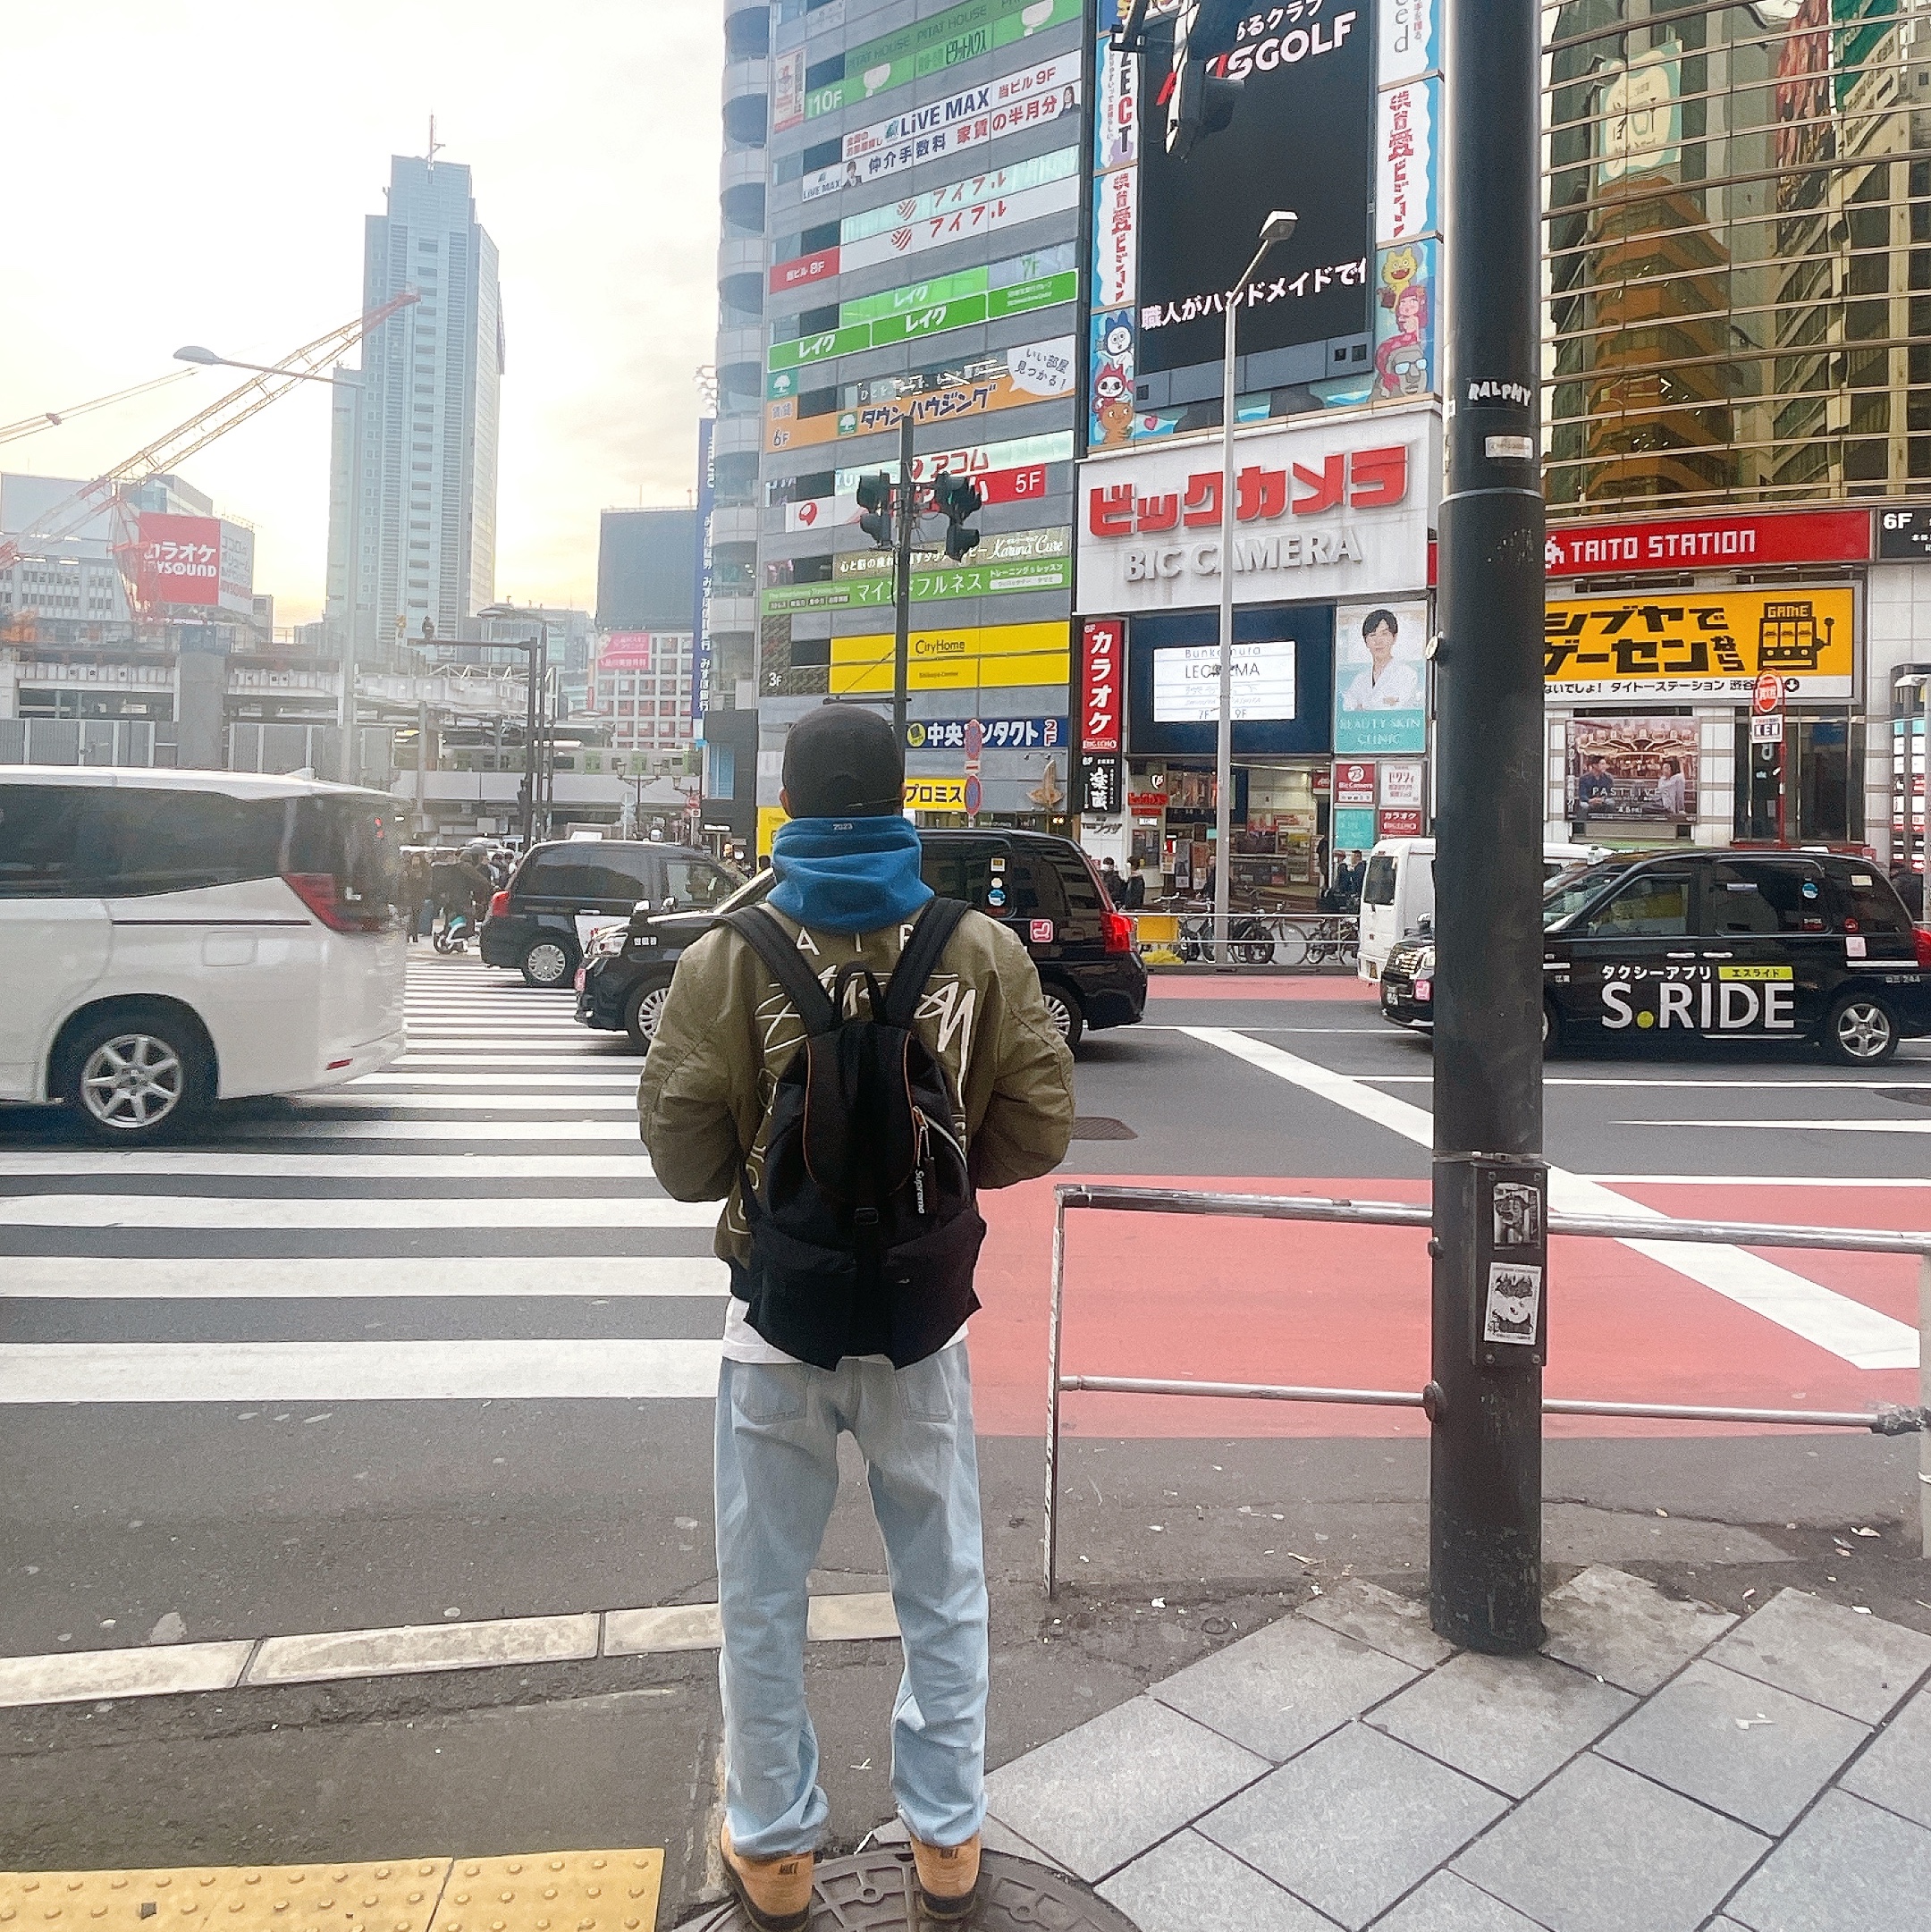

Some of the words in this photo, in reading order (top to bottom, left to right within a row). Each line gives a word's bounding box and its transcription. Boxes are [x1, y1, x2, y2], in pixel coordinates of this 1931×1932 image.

[1036, 66, 1057, 85] 9F
[945, 87, 991, 121] MAX
[868, 133, 946, 174] 仲介手数料
[932, 173, 1007, 208] アイフル
[930, 199, 1007, 239] アイフル
[895, 285, 929, 308] レイク
[905, 305, 947, 333] レイク
[797, 333, 836, 359] レイク
[1026, 348, 1070, 375] いい部屋
[860, 384, 997, 429] タウンハウジング
[1468, 381, 1531, 407] RALPHY
[772, 430, 789, 447] 6F
[930, 449, 990, 479] アコム
[1014, 471, 1041, 494] 5F
[1089, 445, 1408, 536] ビックカメラ
[1883, 512, 1913, 530] 6F
[1125, 546, 1183, 584] BIC
[1191, 530, 1363, 576] CAMERA
[1570, 536, 1639, 563] TAITO
[1649, 529, 1757, 558] STATION
[143, 561, 217, 578] YSOUND
[857, 573, 982, 603] マインフルネス
[1545, 604, 1730, 637] シブヤで
[1767, 604, 1809, 618] GAME
[915, 638, 966, 654] CityHome
[768, 671, 782, 688] 3F
[1088, 631, 1113, 735] カラオケ
[905, 783, 963, 803] プロミス
[1601, 965, 1712, 982] タクシーアプリ
[1732, 967, 1781, 979] エスライド
[1601, 982, 1795, 1030] S.RIDE
